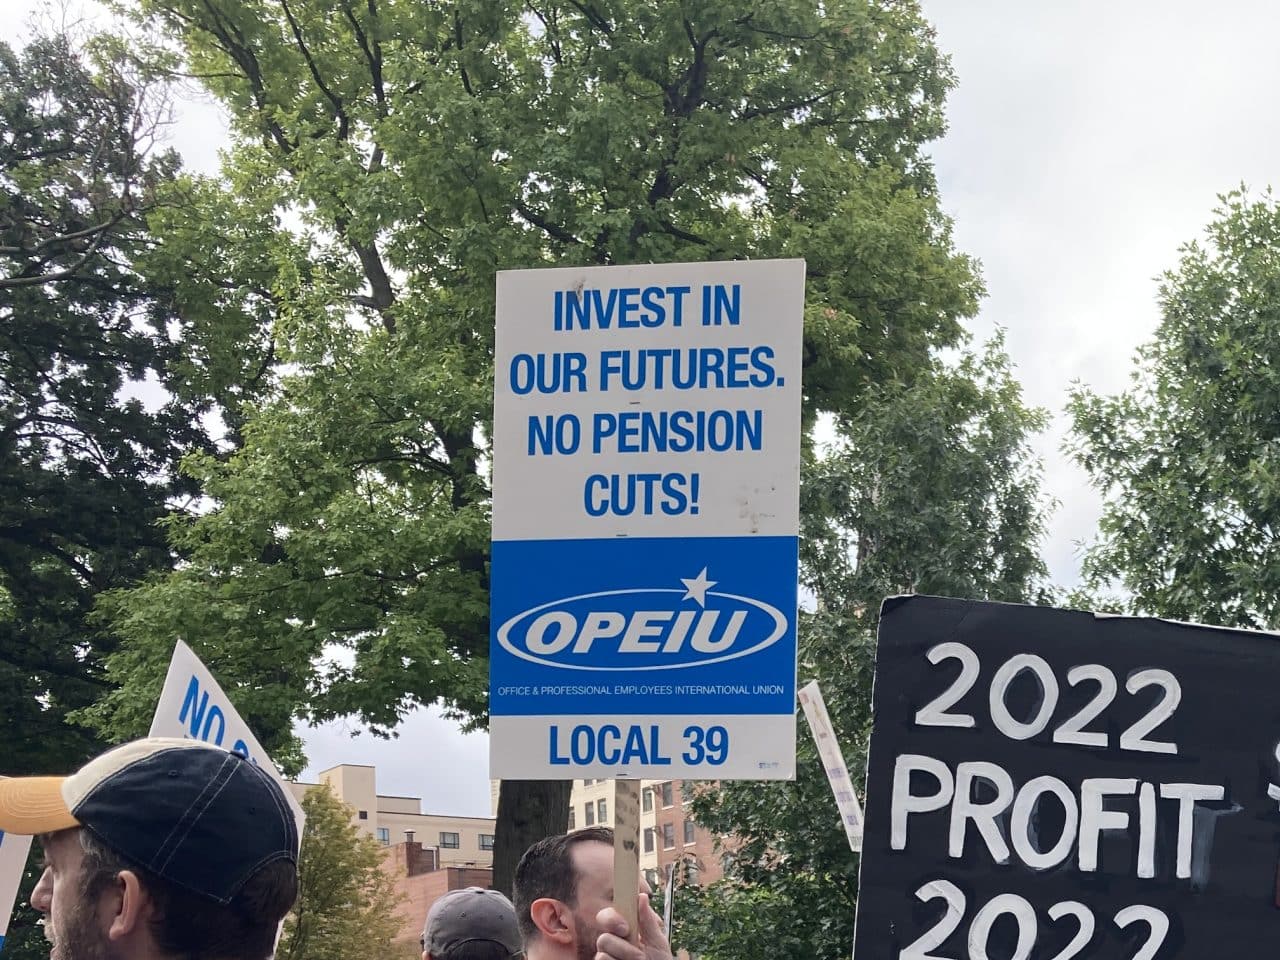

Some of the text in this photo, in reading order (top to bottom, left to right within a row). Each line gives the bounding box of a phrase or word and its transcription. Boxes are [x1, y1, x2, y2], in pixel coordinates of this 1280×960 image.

[553, 284, 741, 331] INVEST IN
[509, 346, 786, 395] OUR FUTURES.
[528, 409, 763, 456] NO PENSION
[584, 472, 700, 517] CUTS!
[525, 609, 750, 654] OPEIU
[497, 684, 784, 696] OFFICE & PROFESSIONAL EMPLOYEES INTERNATIONAL UNION
[914, 641, 1183, 755] 2022
[549, 724, 729, 766] LOCAL 39
[890, 753, 1227, 880] PROFIT
